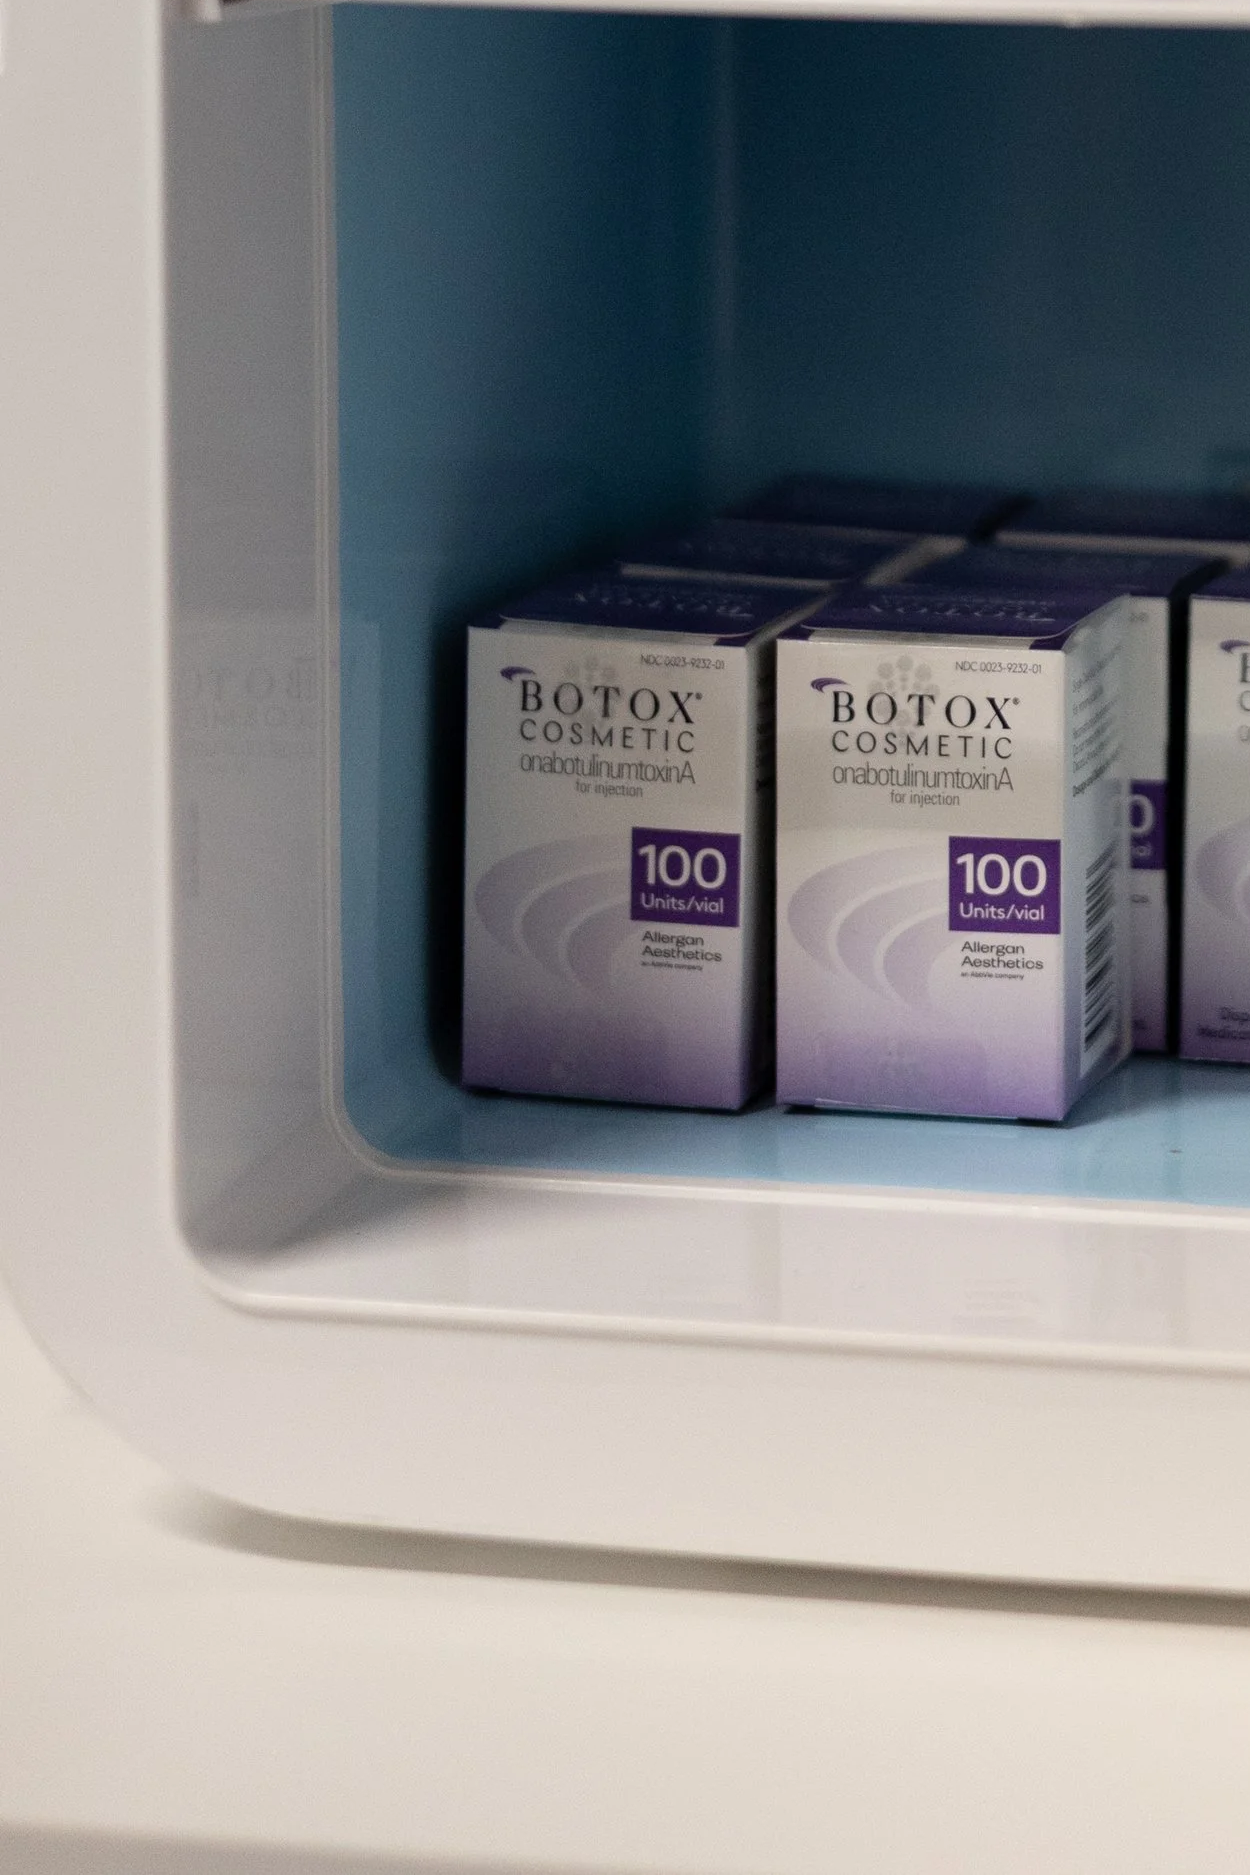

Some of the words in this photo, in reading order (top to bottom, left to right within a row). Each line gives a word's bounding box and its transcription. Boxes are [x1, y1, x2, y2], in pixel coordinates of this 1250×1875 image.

[955, 660, 978, 672] NDC
[980, 661, 1043, 674] 0023-9232-01
[519, 718, 695, 754] COSMETIC
[832, 730, 1013, 759] COSMETIC
[519, 750, 696, 785] onabotulinumtoxinA
[832, 761, 1014, 791] onabotulinumtoxinA
[575, 780, 591, 794] for
[594, 782, 644, 798] injection
[890, 790, 908, 804] for
[909, 790, 960, 808] injection
[637, 843, 728, 890] 100
[955, 852, 1048, 897] 100
[640, 892, 724, 914] Units/vial
[959, 902, 1045, 921] Units/vial
[641, 930, 705, 947] Allergan
[961, 940, 1025, 956] Allergan
[641, 945, 723, 962] Aesthetics
[961, 955, 1044, 970] Aesthetics
